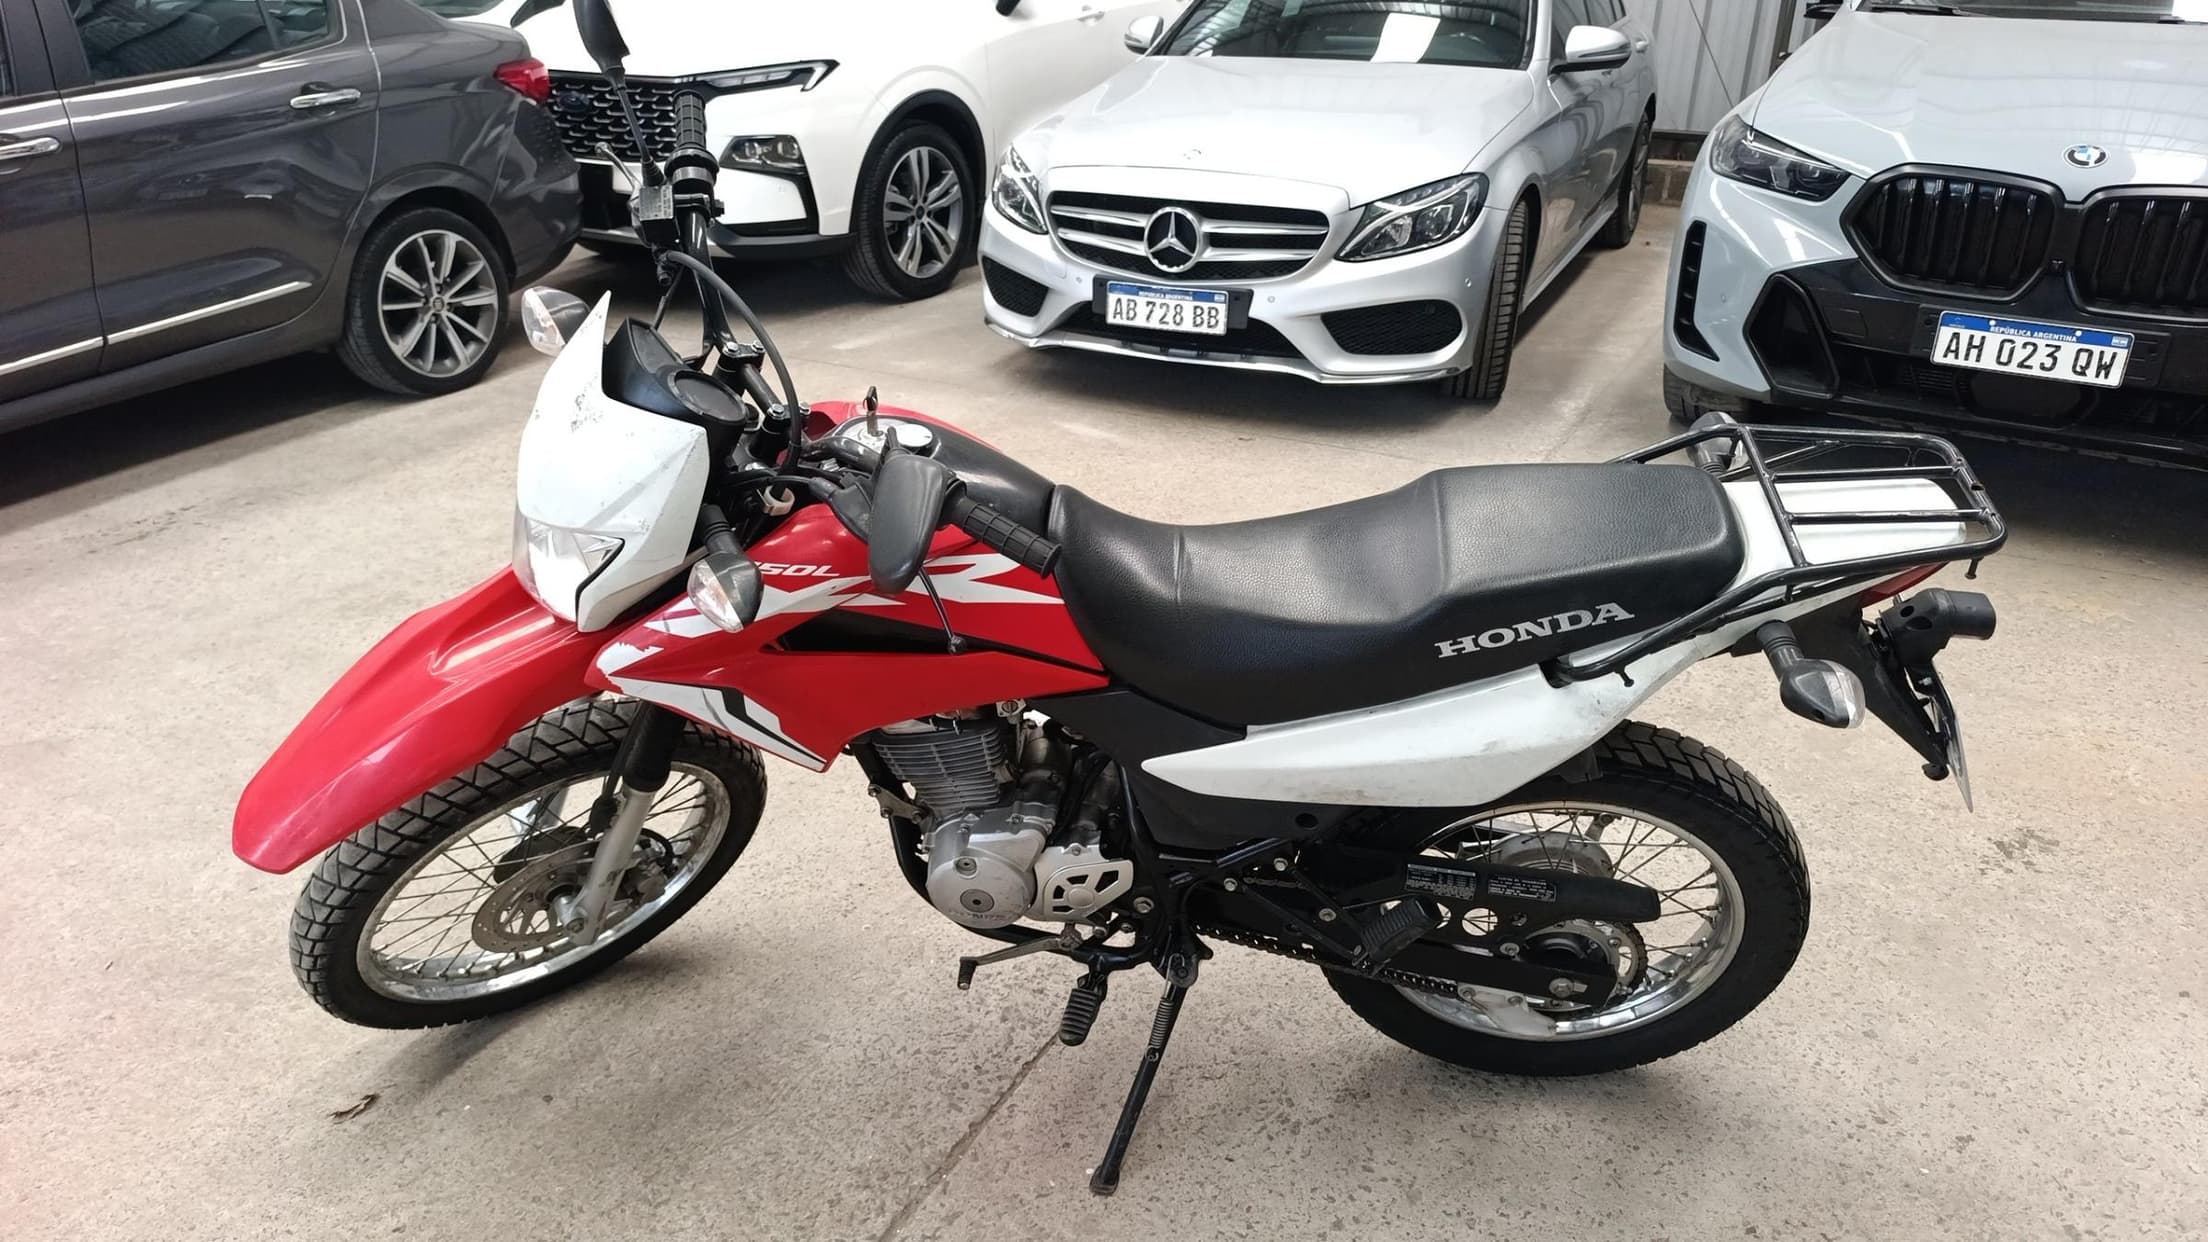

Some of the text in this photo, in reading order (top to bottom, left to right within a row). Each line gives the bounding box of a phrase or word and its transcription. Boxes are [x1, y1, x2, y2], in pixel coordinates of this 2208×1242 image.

[1112, 298, 1220, 329] AB 728 BB
[1942, 331, 2118, 380] AH 023 QW
[2032, 330, 2078, 343] ARGENTINA
[1434, 602, 1636, 659] HONDA
